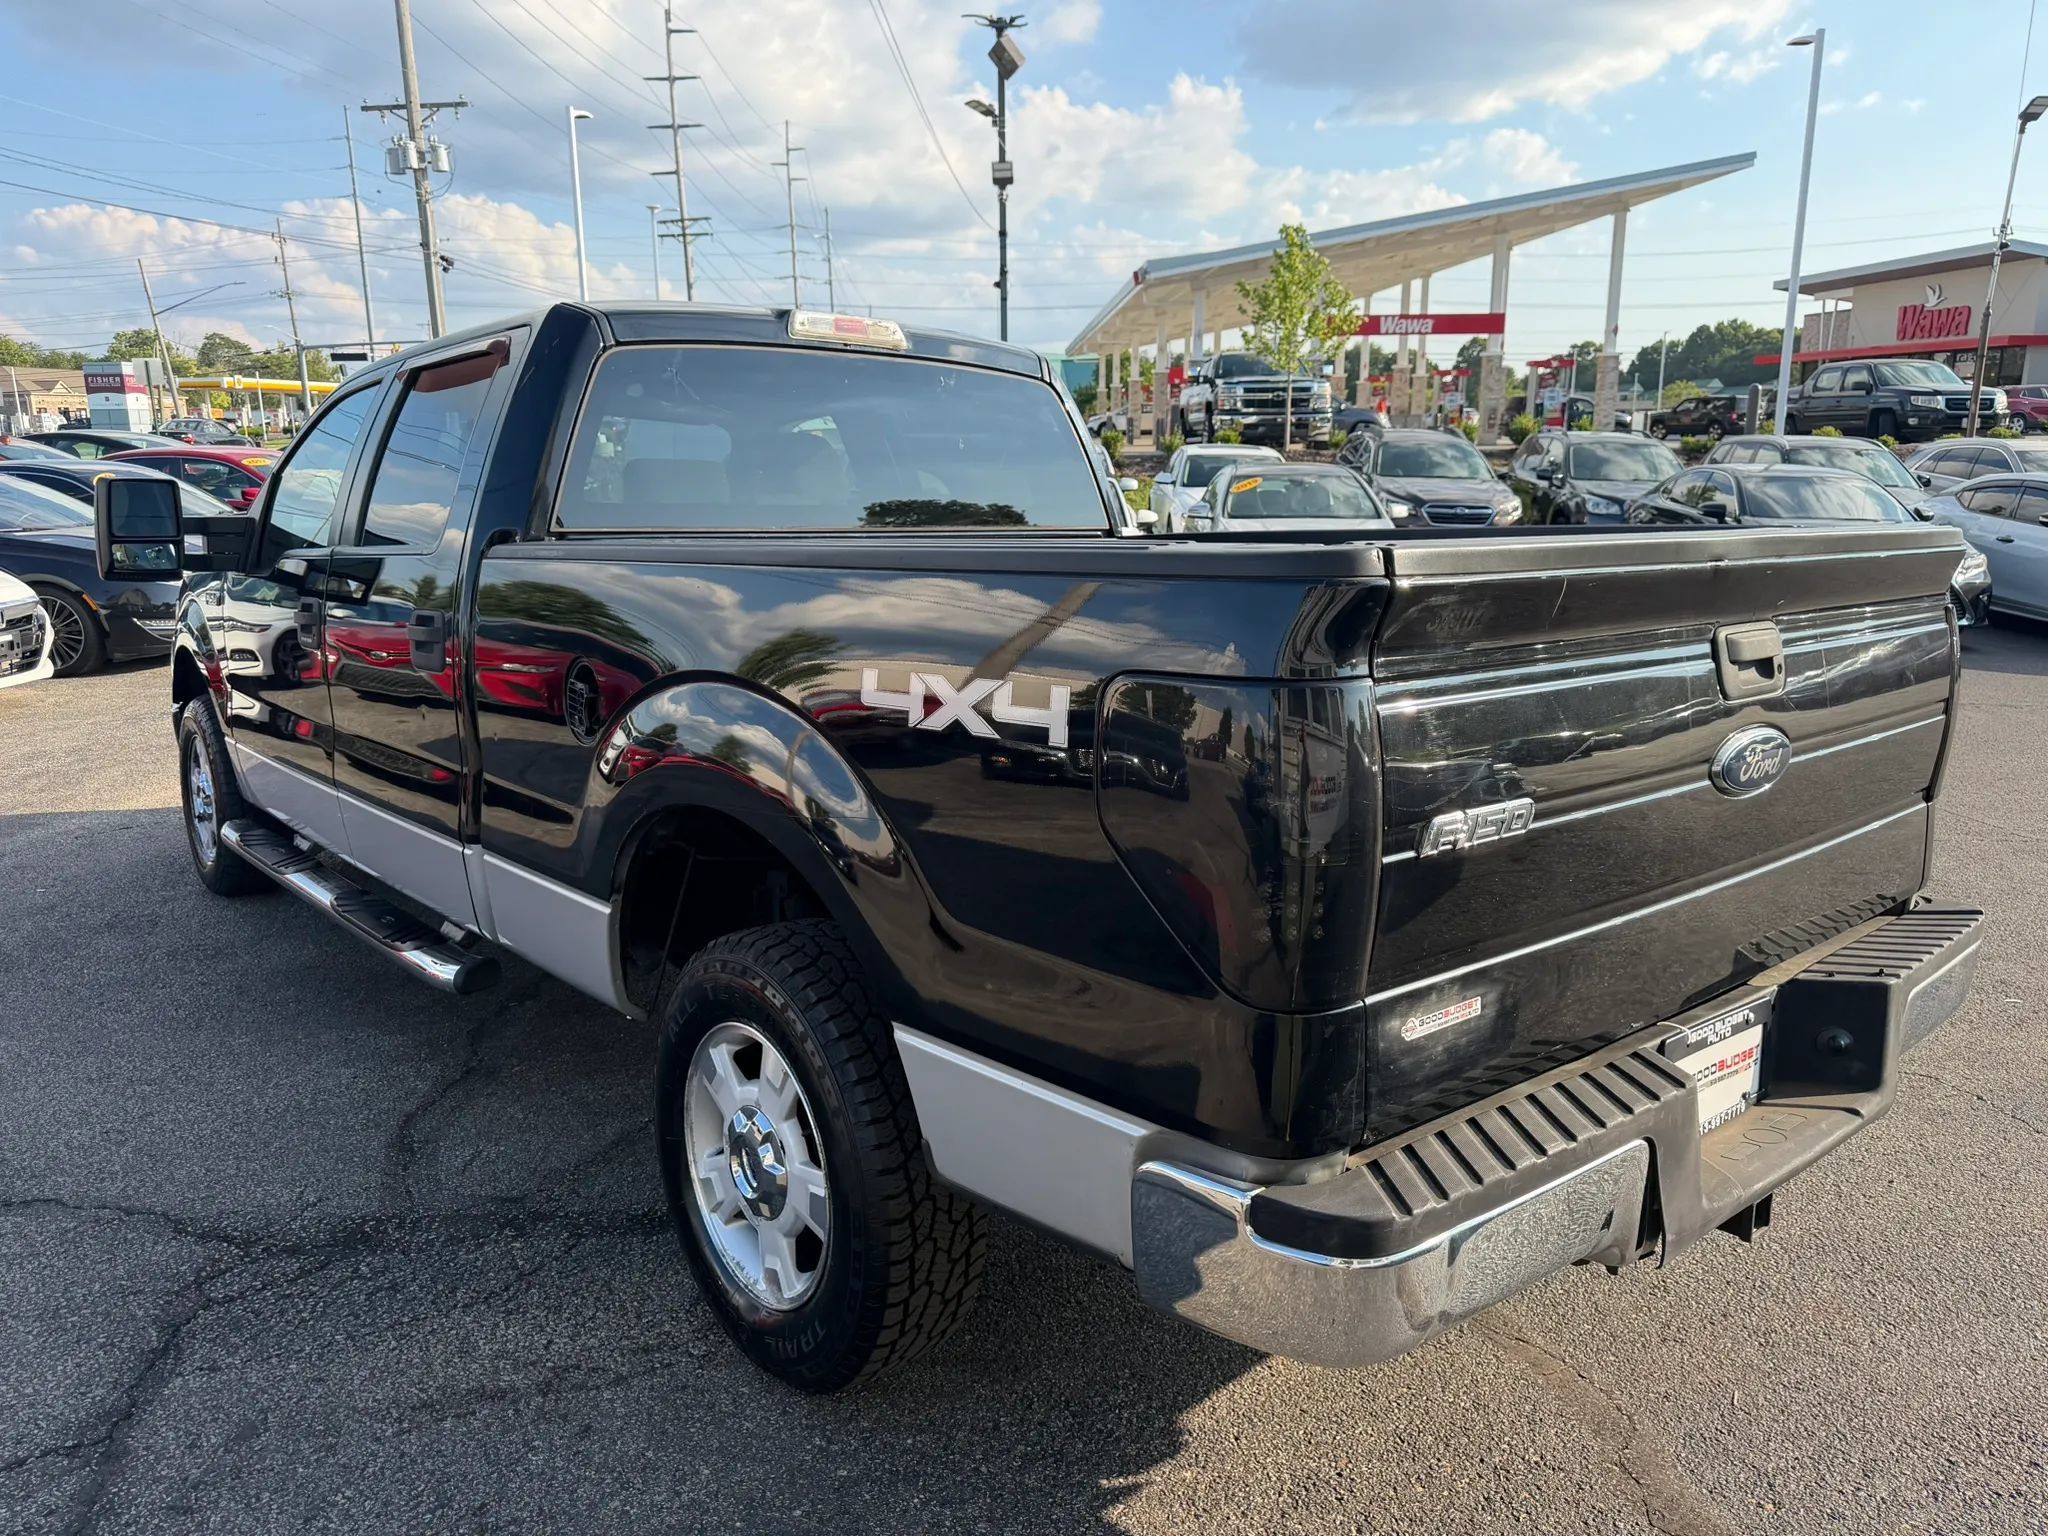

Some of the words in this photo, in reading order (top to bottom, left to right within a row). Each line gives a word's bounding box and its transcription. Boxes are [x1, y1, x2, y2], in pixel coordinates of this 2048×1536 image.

[1379, 315, 1434, 334] Wawa
[1896, 303, 1972, 341] Wawa
[861, 667, 1071, 748] 4X4
[1739, 738, 1783, 782] Ford
[1691, 1024, 1714, 1043] GOOD
[1715, 1009, 1750, 1033] BUDGET
[1707, 1027, 1732, 1045] AUTO
[1699, 1100, 1746, 1135] 13-997-7779
